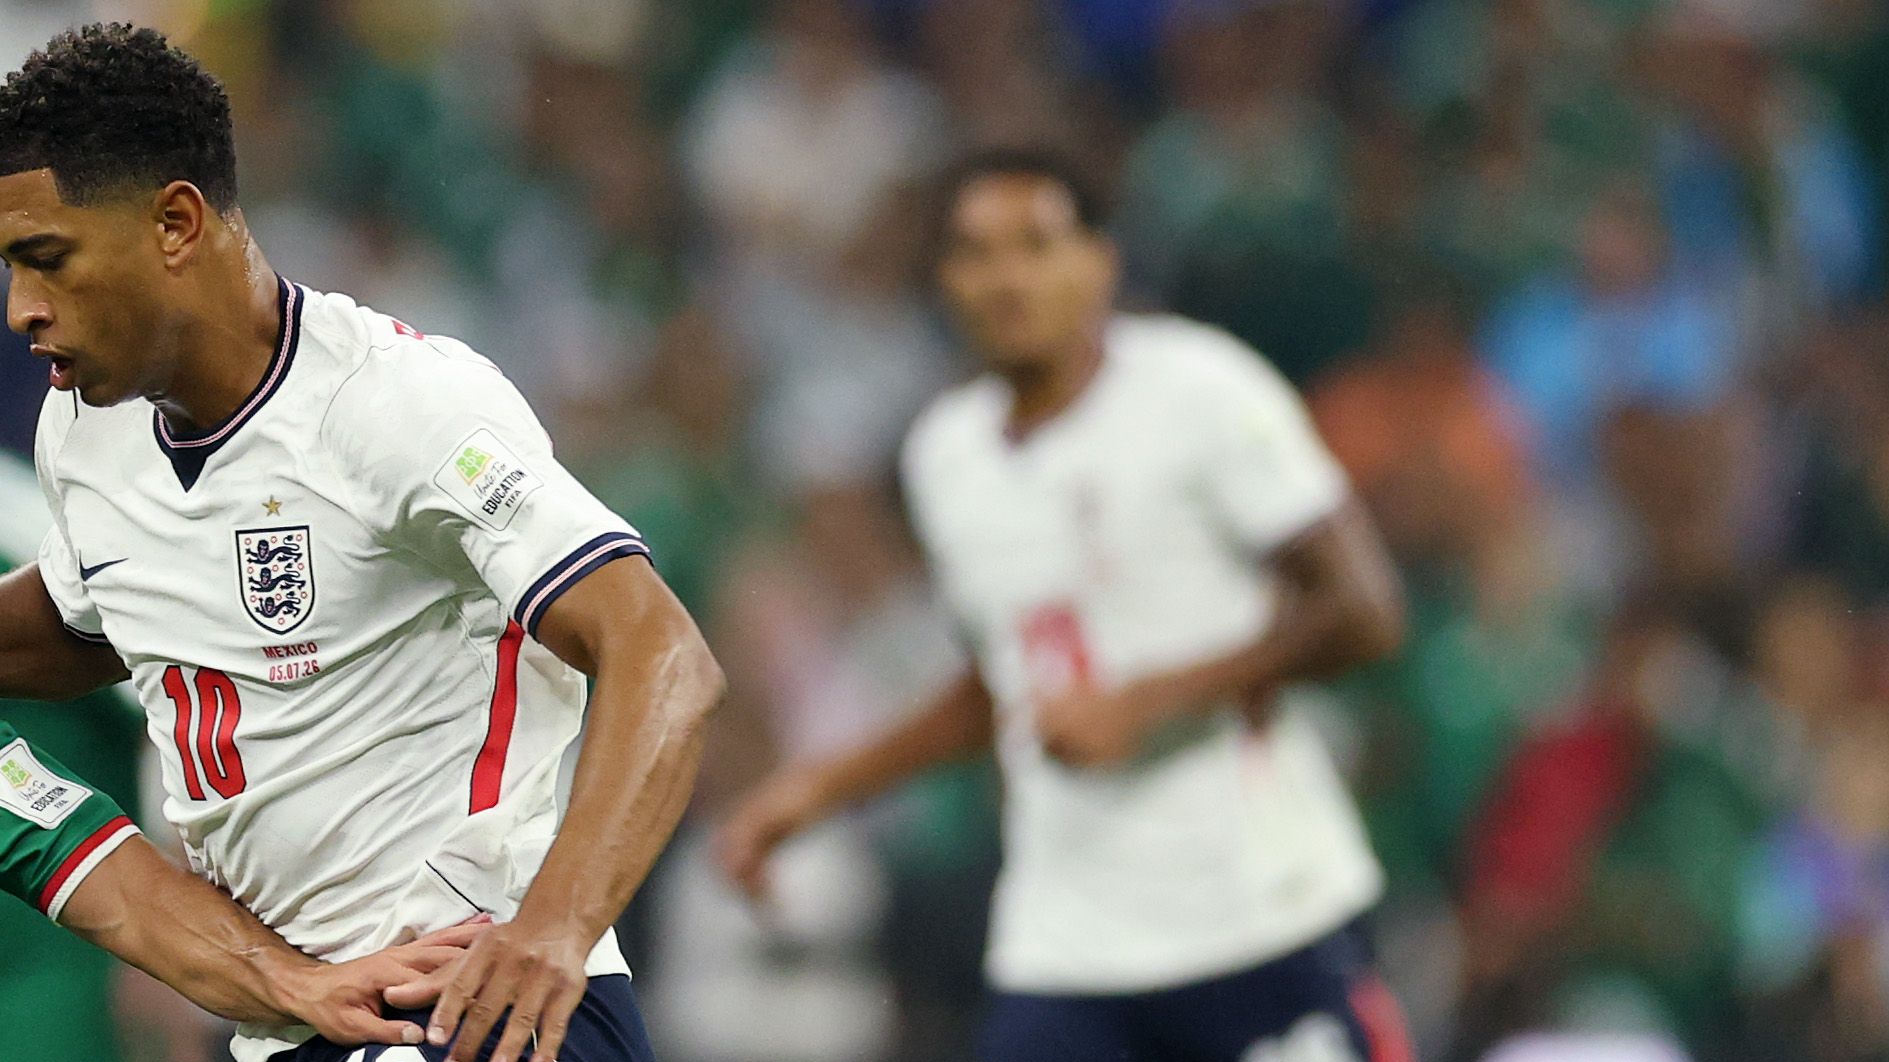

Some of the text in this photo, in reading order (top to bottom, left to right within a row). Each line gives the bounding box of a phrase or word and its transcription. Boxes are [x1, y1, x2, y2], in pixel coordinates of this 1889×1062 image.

[481, 468, 527, 515] EDUCATION
[504, 489, 522, 508] FIFA
[262, 641, 318, 659] MEXICO
[269, 659, 321, 682] 05.07.26
[161, 664, 248, 801] 10
